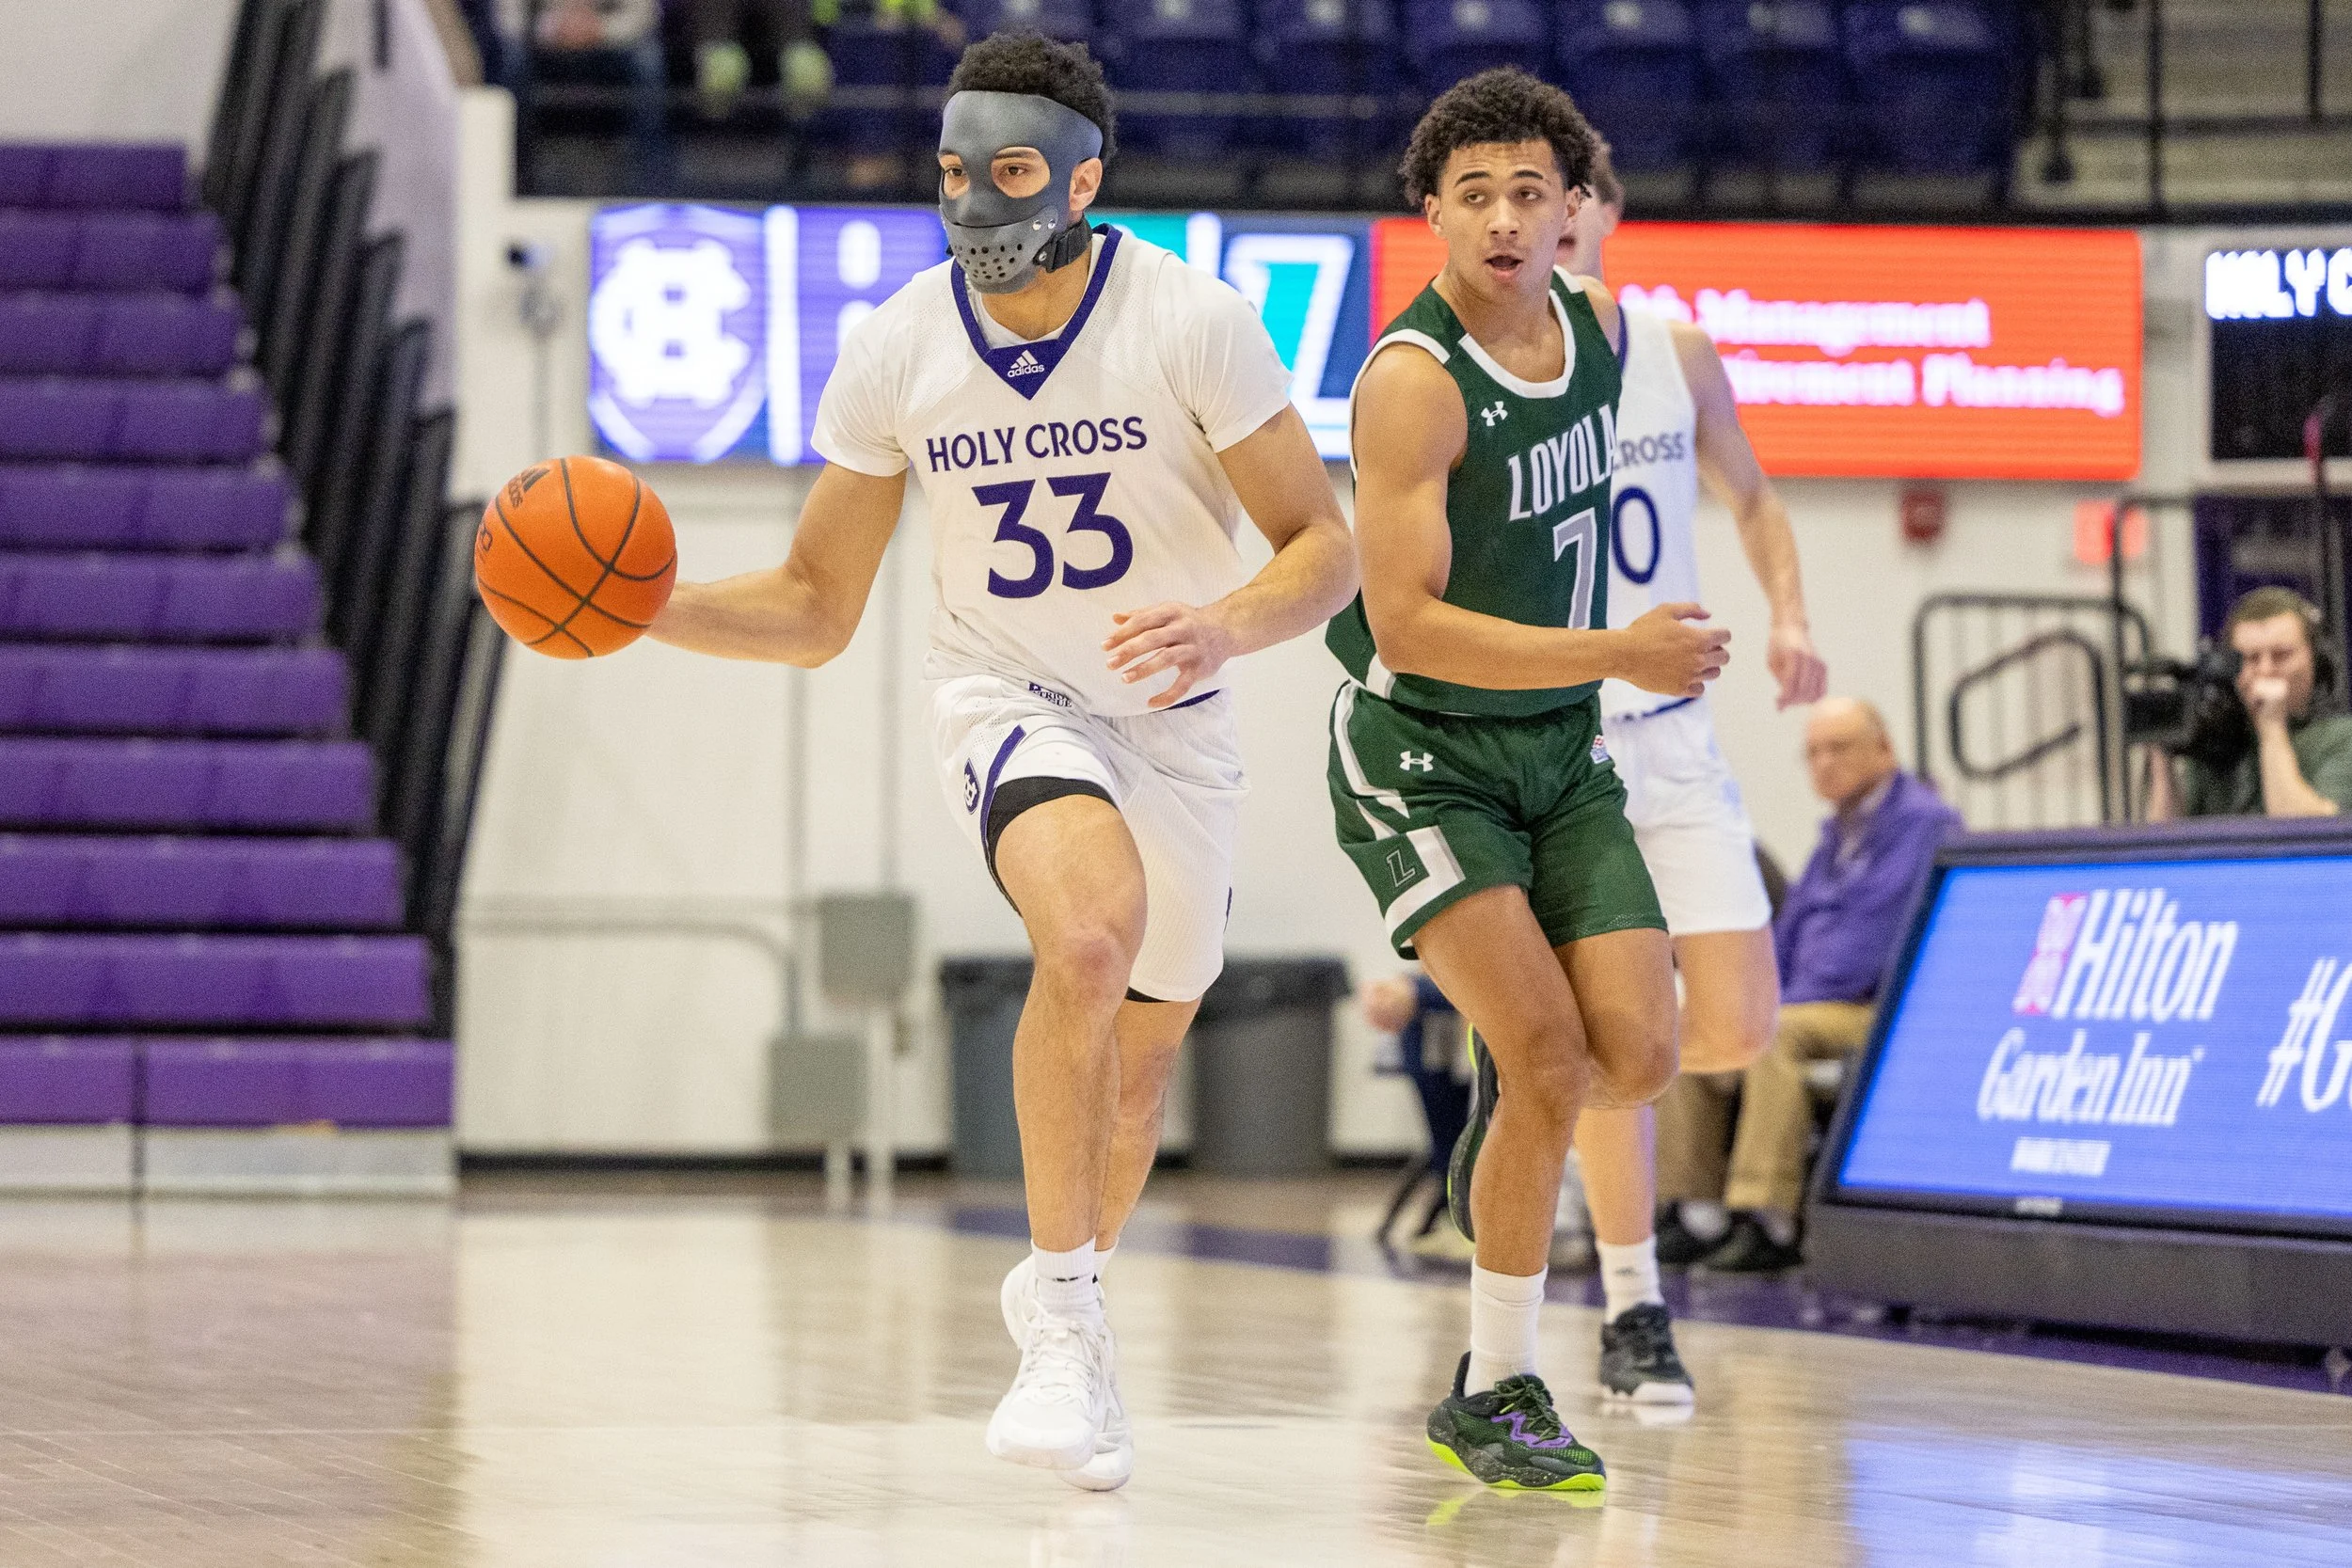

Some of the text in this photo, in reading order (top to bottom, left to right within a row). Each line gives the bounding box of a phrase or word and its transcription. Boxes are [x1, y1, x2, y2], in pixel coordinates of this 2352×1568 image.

[1007, 362, 1044, 378] adidas
[926, 416, 1148, 472] HOLY CROSS
[1507, 404, 1617, 522] LOYOLA
[971, 472, 1134, 599] 33
[1552, 506, 1597, 629] 7
[1386, 849, 1416, 888] L
[2051, 887, 2239, 1022] Hilton
[1978, 1026, 2193, 1128] Garden Inn
[2254, 956, 2352, 1114] #G
